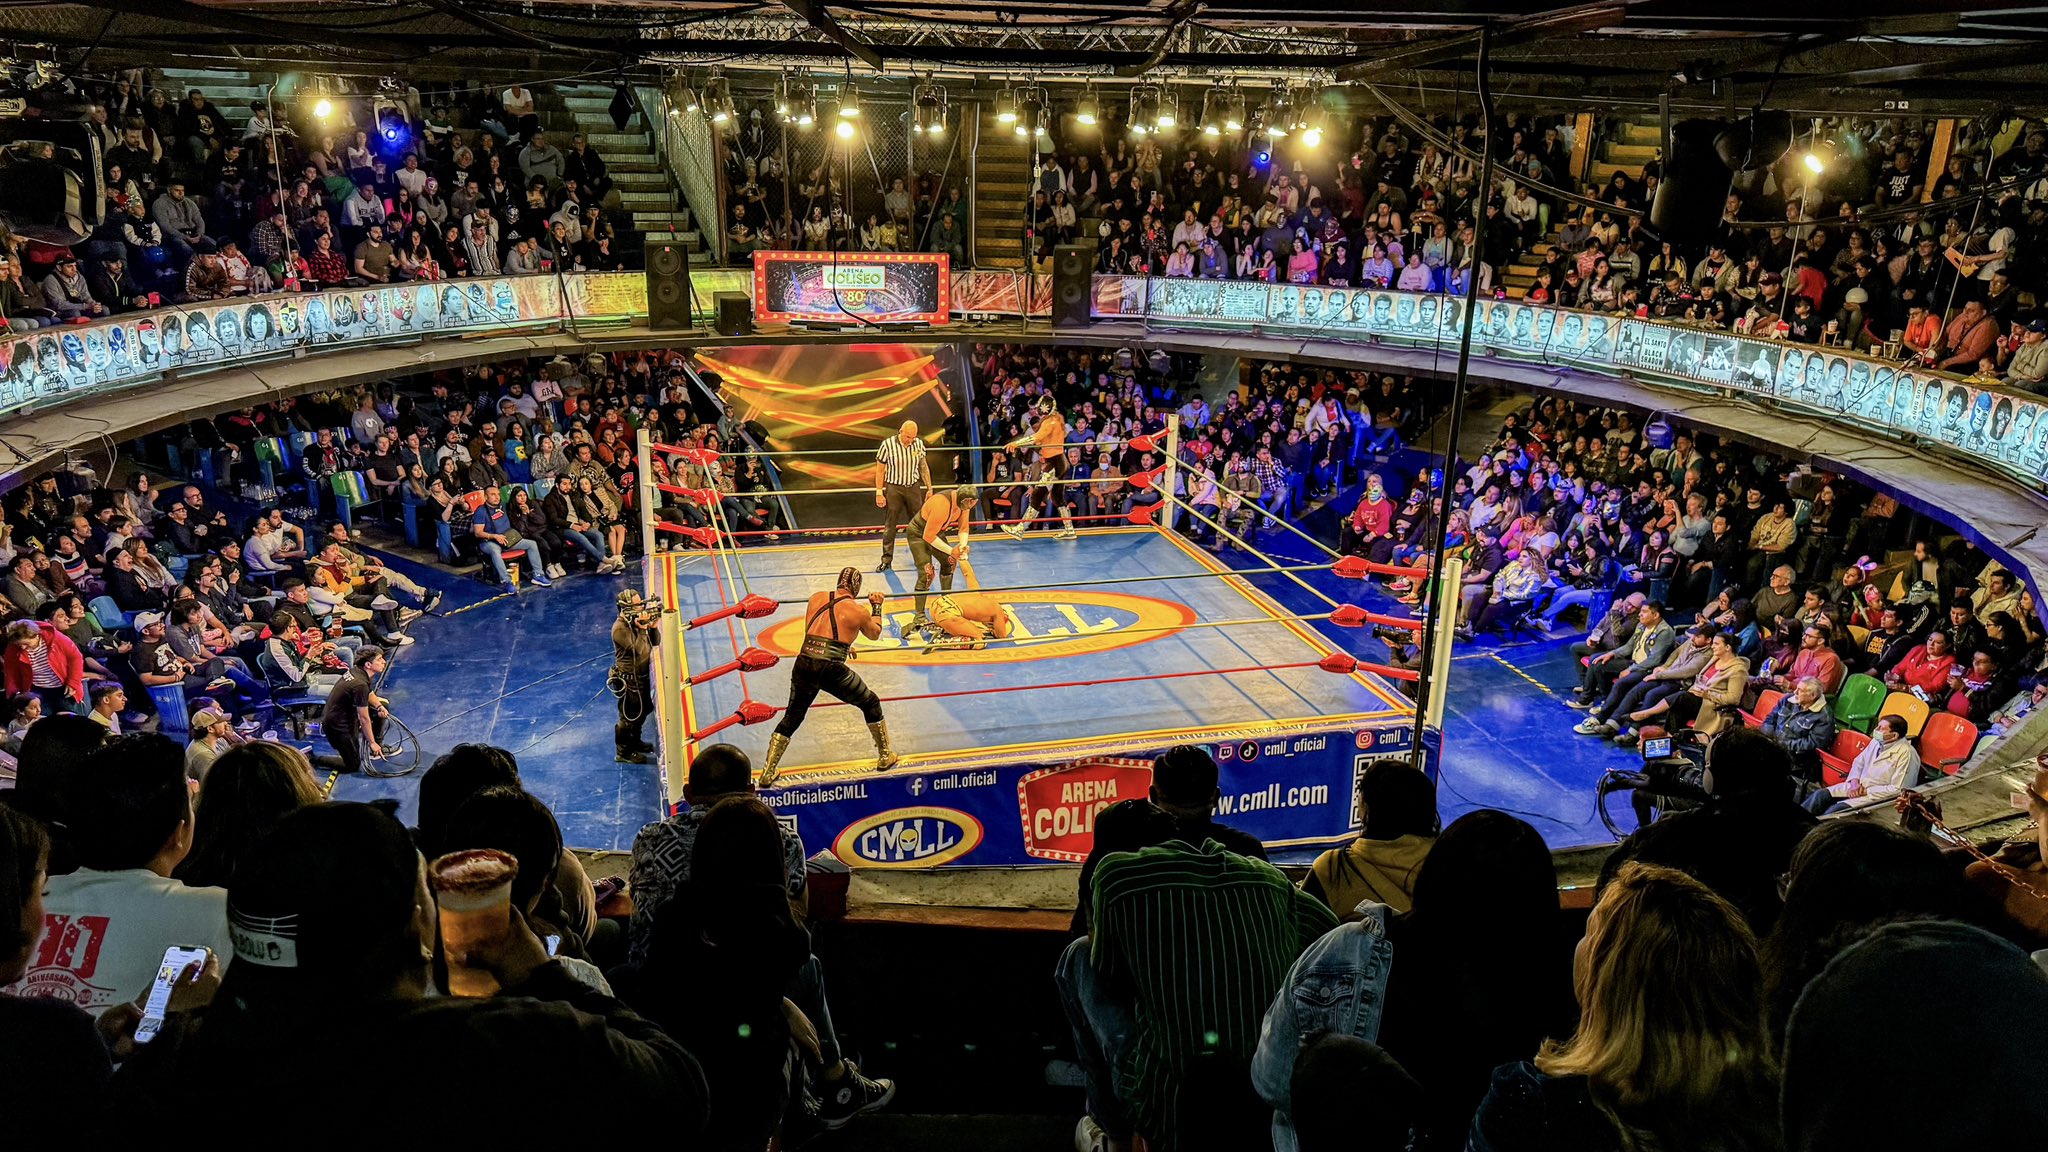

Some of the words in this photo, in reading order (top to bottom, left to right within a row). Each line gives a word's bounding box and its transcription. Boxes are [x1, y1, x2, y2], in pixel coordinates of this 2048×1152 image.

[1889, 175, 1911, 185] JUST
[827, 273, 881, 285] COLISEO
[847, 291, 864, 302] 80
[1651, 339, 1667, 349] SANTO
[1644, 349, 1663, 358] BLACK
[1641, 355, 1663, 366] SHADOW
[1867, 685, 1878, 694] 17
[1264, 736, 1326, 757] cmll_oficial
[933, 770, 997, 791] cmll.oficial
[1061, 779, 1118, 804] ARENA
[1211, 783, 1328, 817] w.cmll.com
[1035, 801, 1114, 840] COLI
[861, 818, 954, 861] CMLL
[27, 973, 76, 987] ANIVERSARIO
